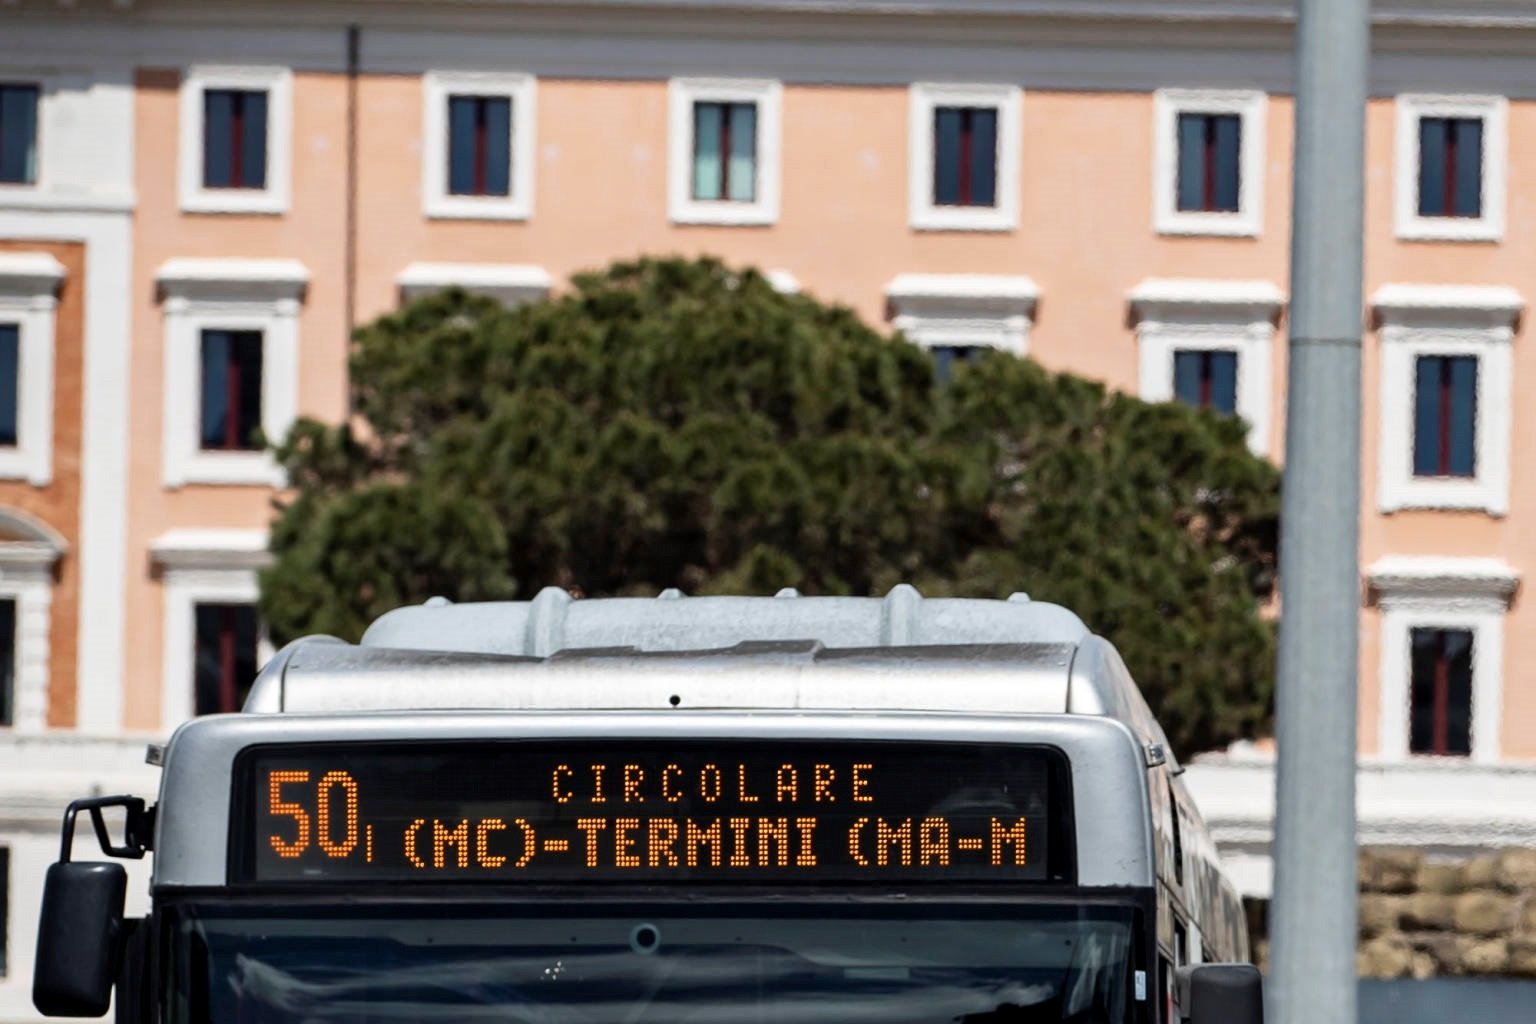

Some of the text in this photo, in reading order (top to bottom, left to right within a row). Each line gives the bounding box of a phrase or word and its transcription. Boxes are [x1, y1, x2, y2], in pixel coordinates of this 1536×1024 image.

[552, 763, 874, 803] CIRCOLARE
[404, 816, 1026, 868] (MC)-TERMINI (MA-M
